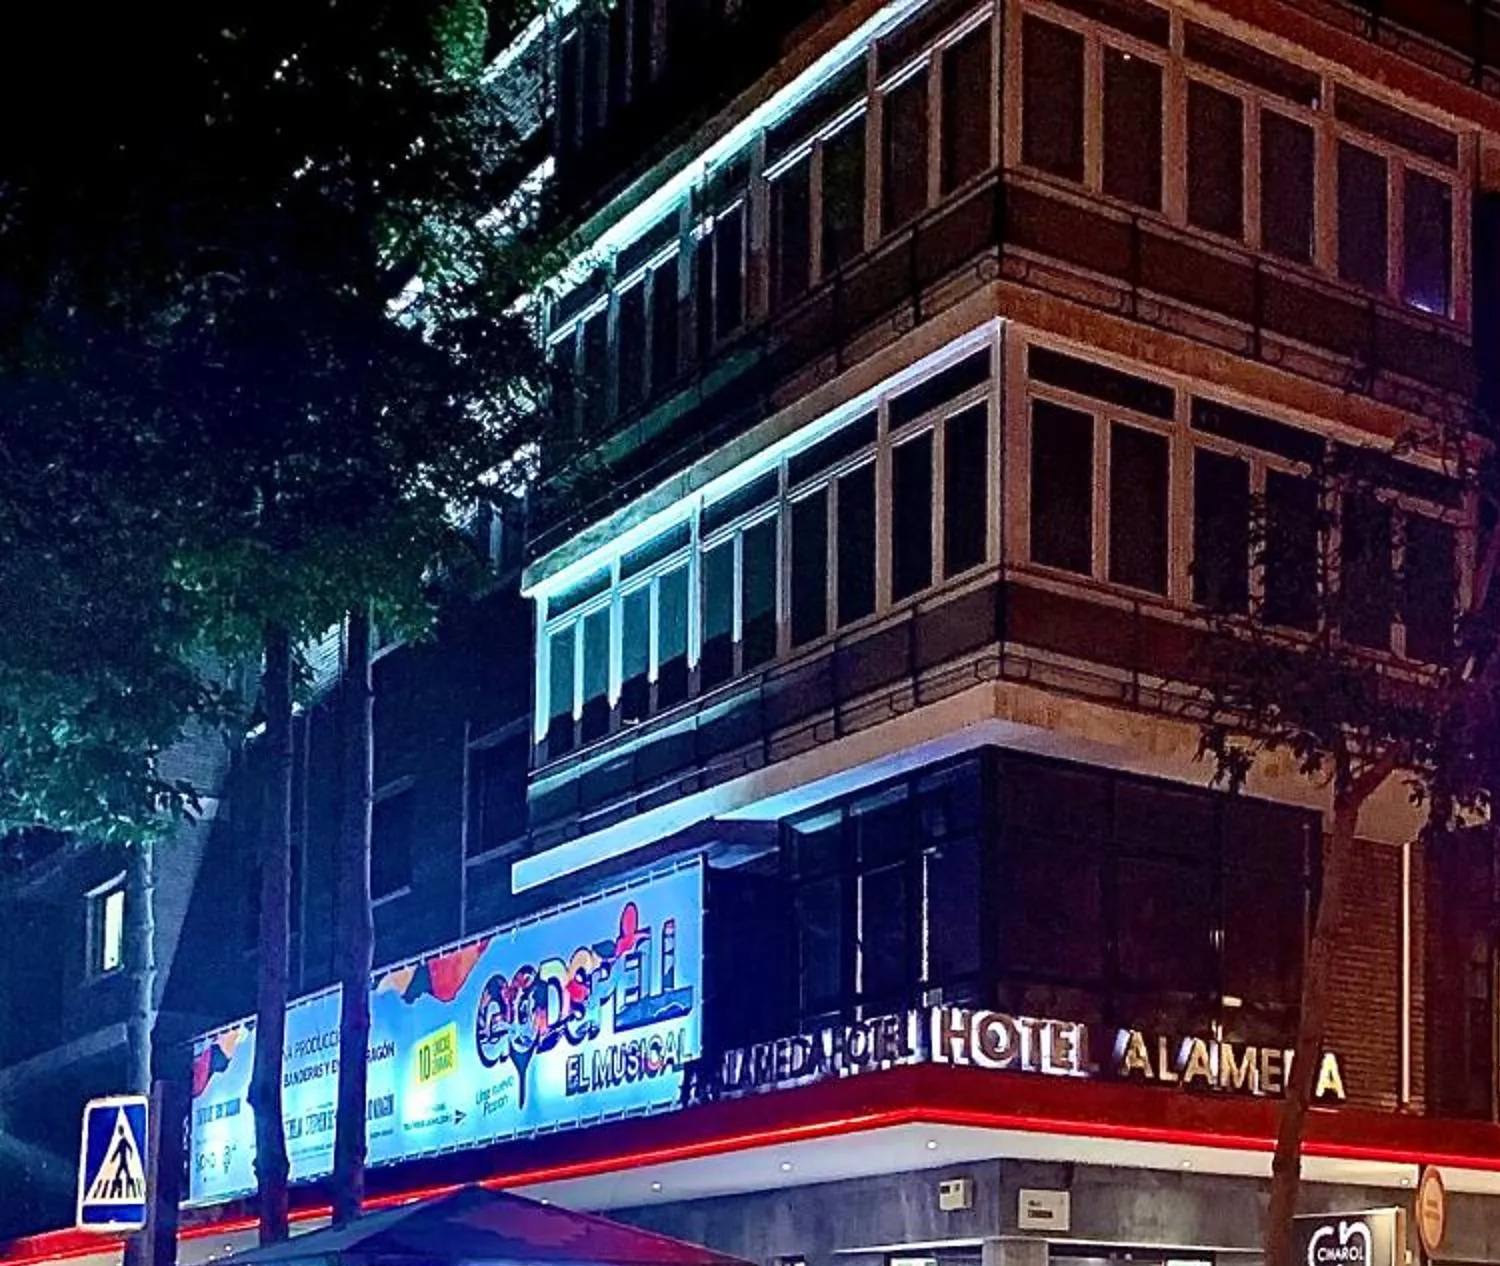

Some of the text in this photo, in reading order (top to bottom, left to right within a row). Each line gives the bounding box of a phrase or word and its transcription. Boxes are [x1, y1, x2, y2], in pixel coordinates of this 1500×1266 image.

[565, 1027, 693, 1097] EL MUSICAL
[931, 1006, 1099, 1077] HOTEL
[1113, 1028, 1346, 1099] ALAMEA
